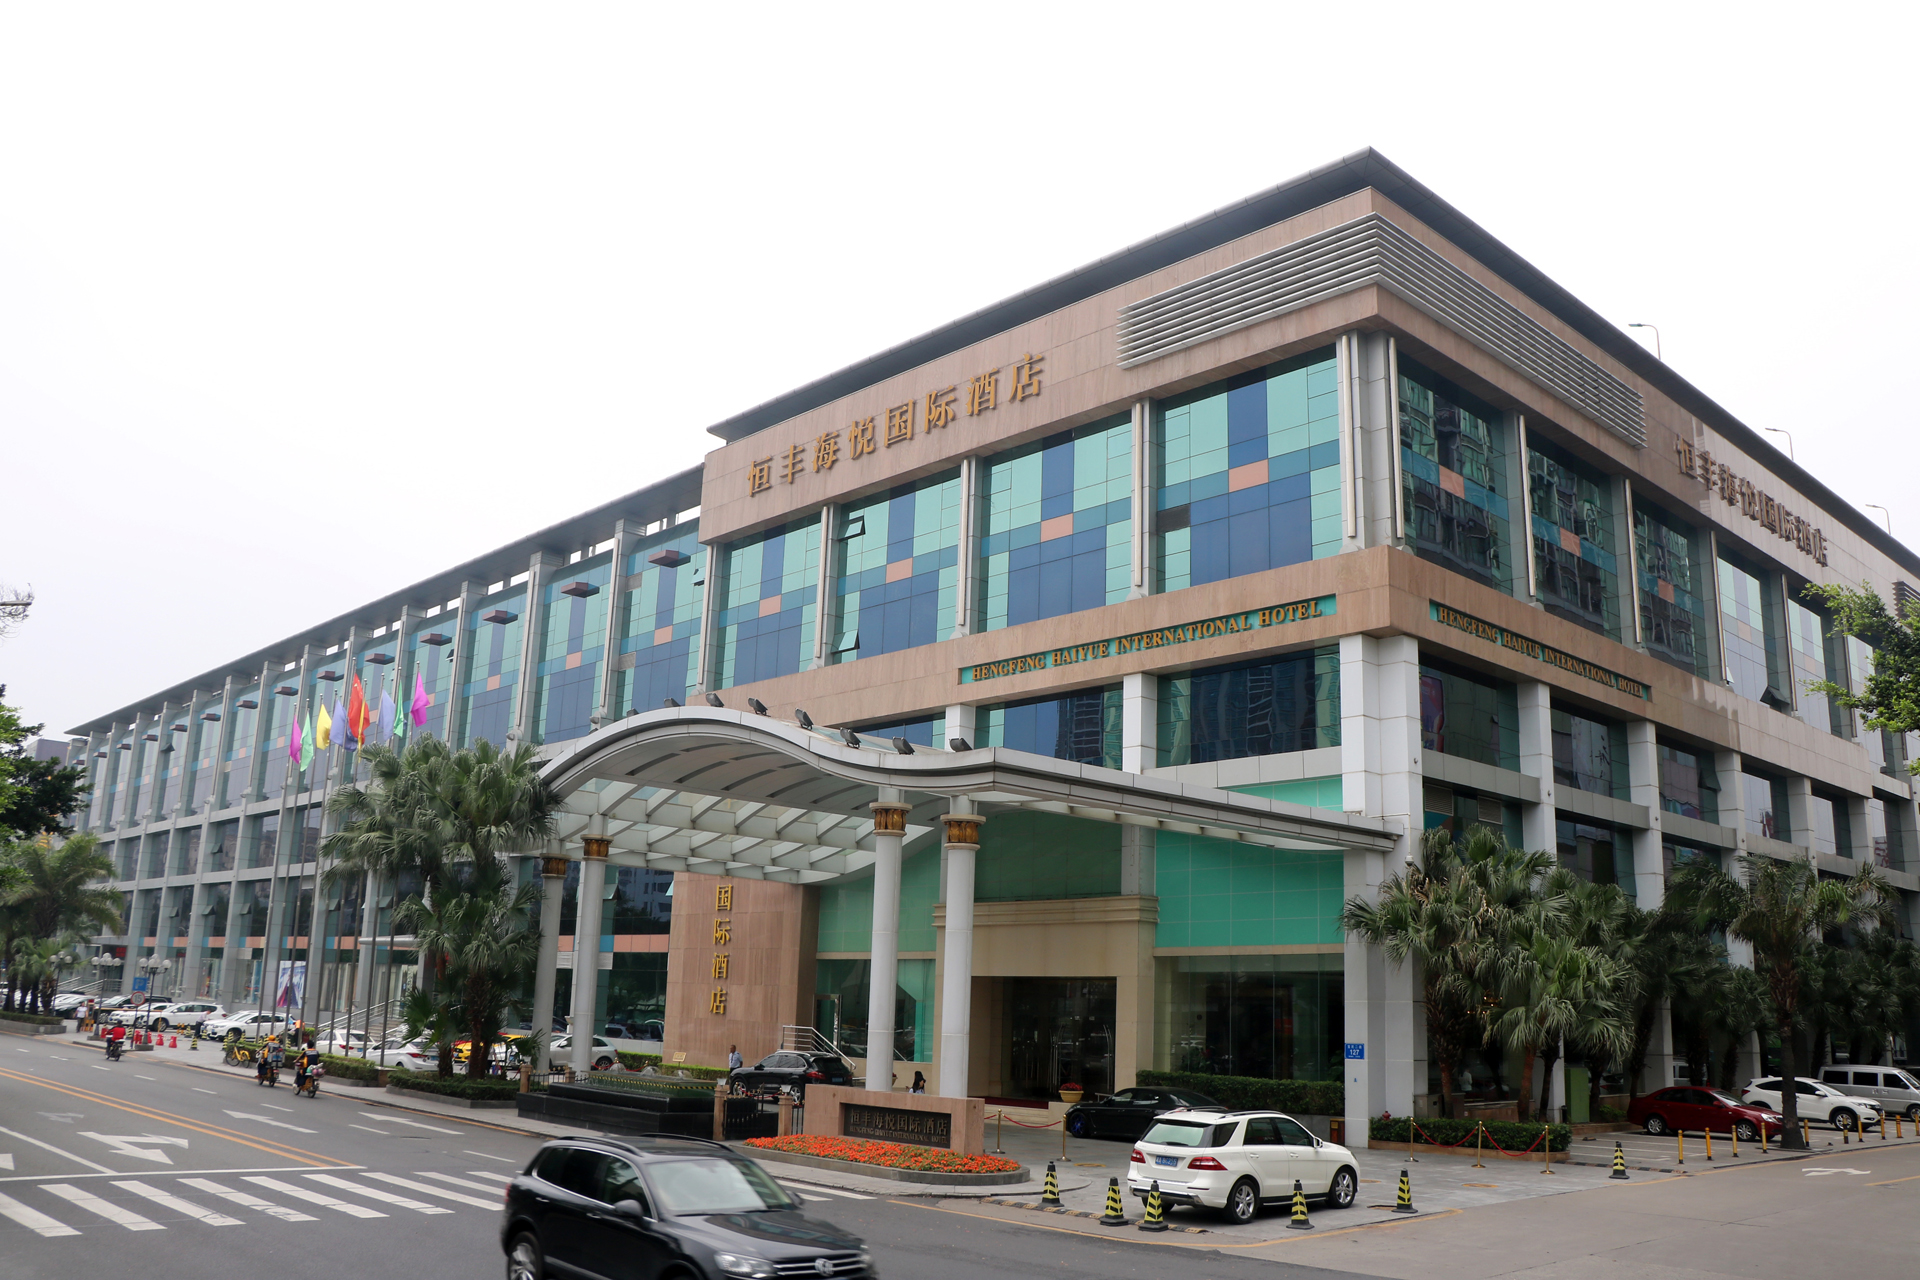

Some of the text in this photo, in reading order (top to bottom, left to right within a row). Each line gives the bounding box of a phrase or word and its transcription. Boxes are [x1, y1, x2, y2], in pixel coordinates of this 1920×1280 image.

[746, 353, 1044, 498] 恒丰海悦国际酒店
[972, 600, 1322, 680] HENGFENG HAIYUE INTERNATIONAL HOTEL
[1439, 606, 1644, 698] HENGFENG HAIYUE INTERNATIONAL HOTEL
[709, 876, 733, 1015] 国际酒店
[850, 1109, 948, 1135] 恒丰海悦国际酒店
